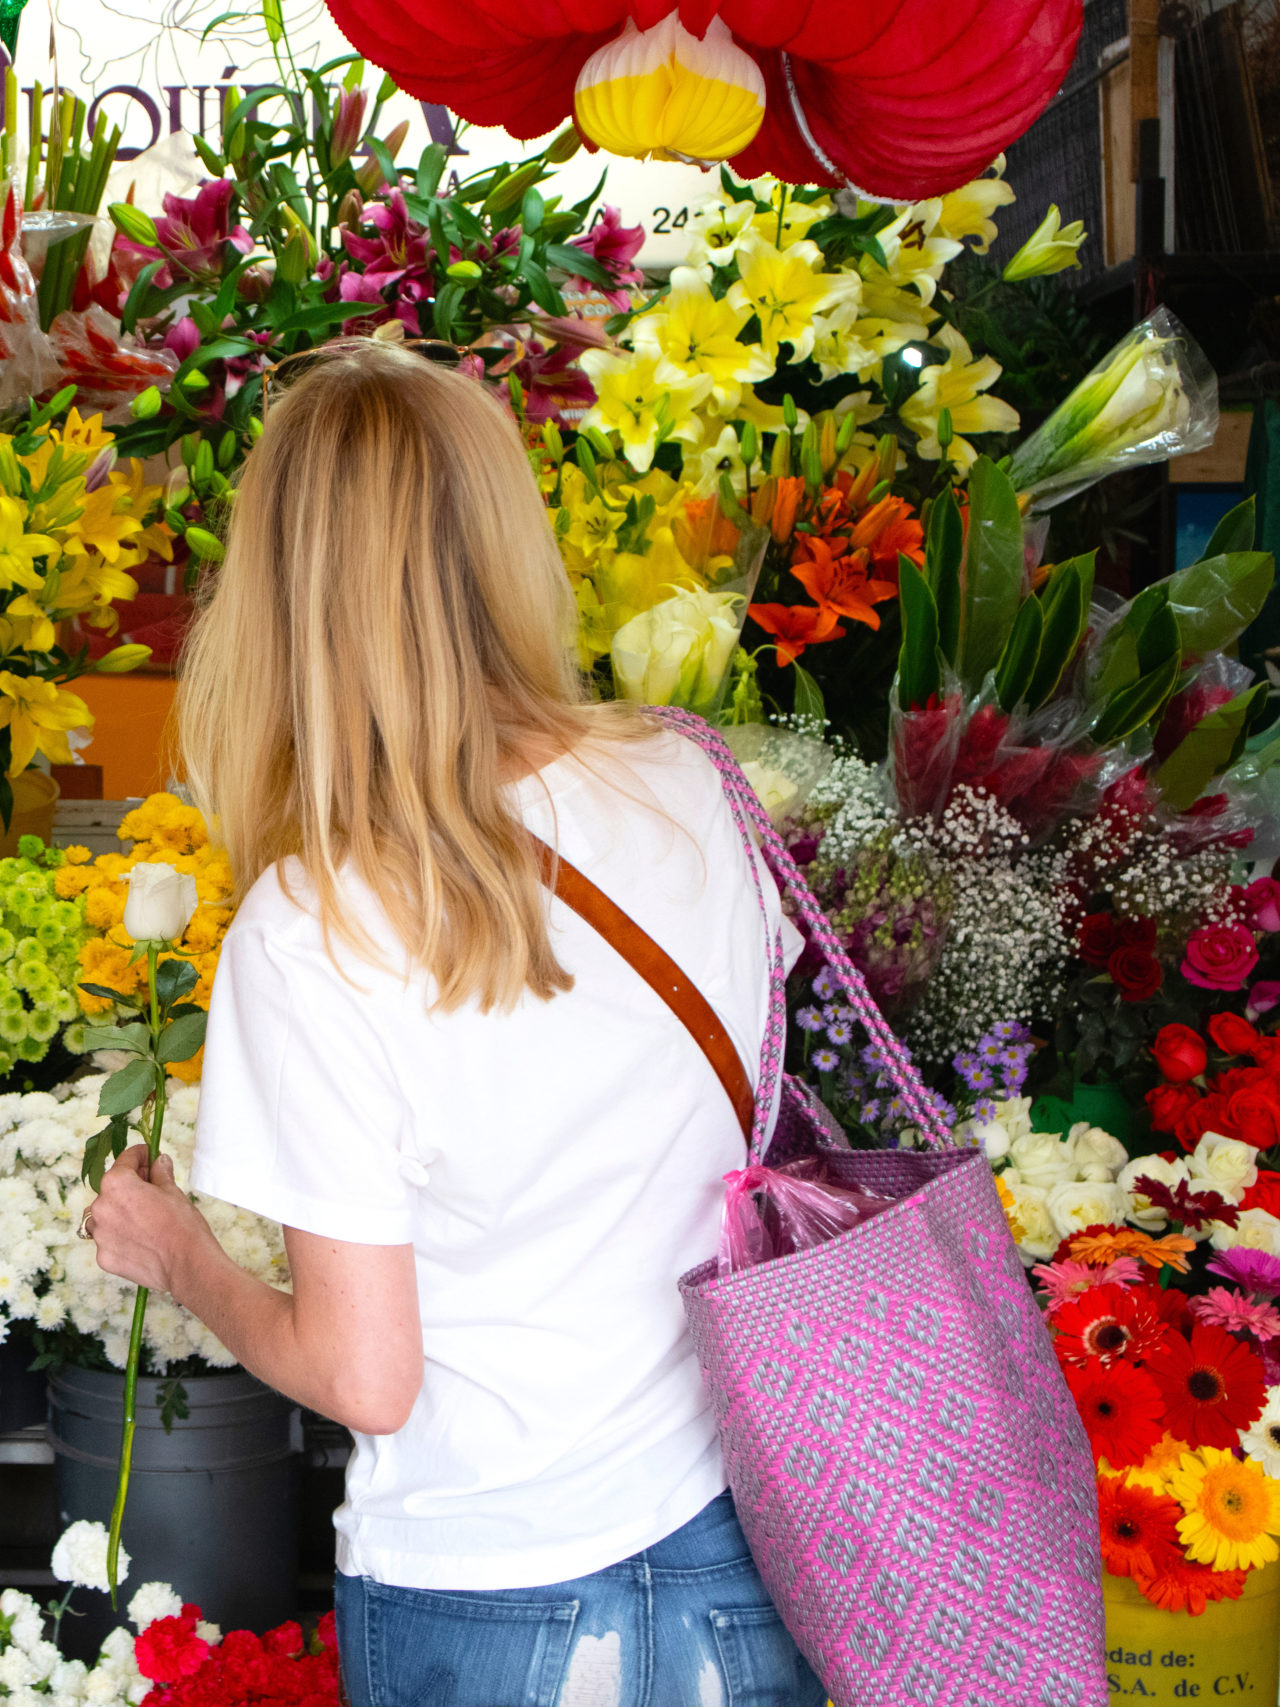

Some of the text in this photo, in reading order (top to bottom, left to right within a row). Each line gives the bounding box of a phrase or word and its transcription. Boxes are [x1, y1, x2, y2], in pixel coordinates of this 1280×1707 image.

[1105, 1647, 1195, 1668] dad de:
[1107, 1672, 1254, 1697] S.A. de C.V.
